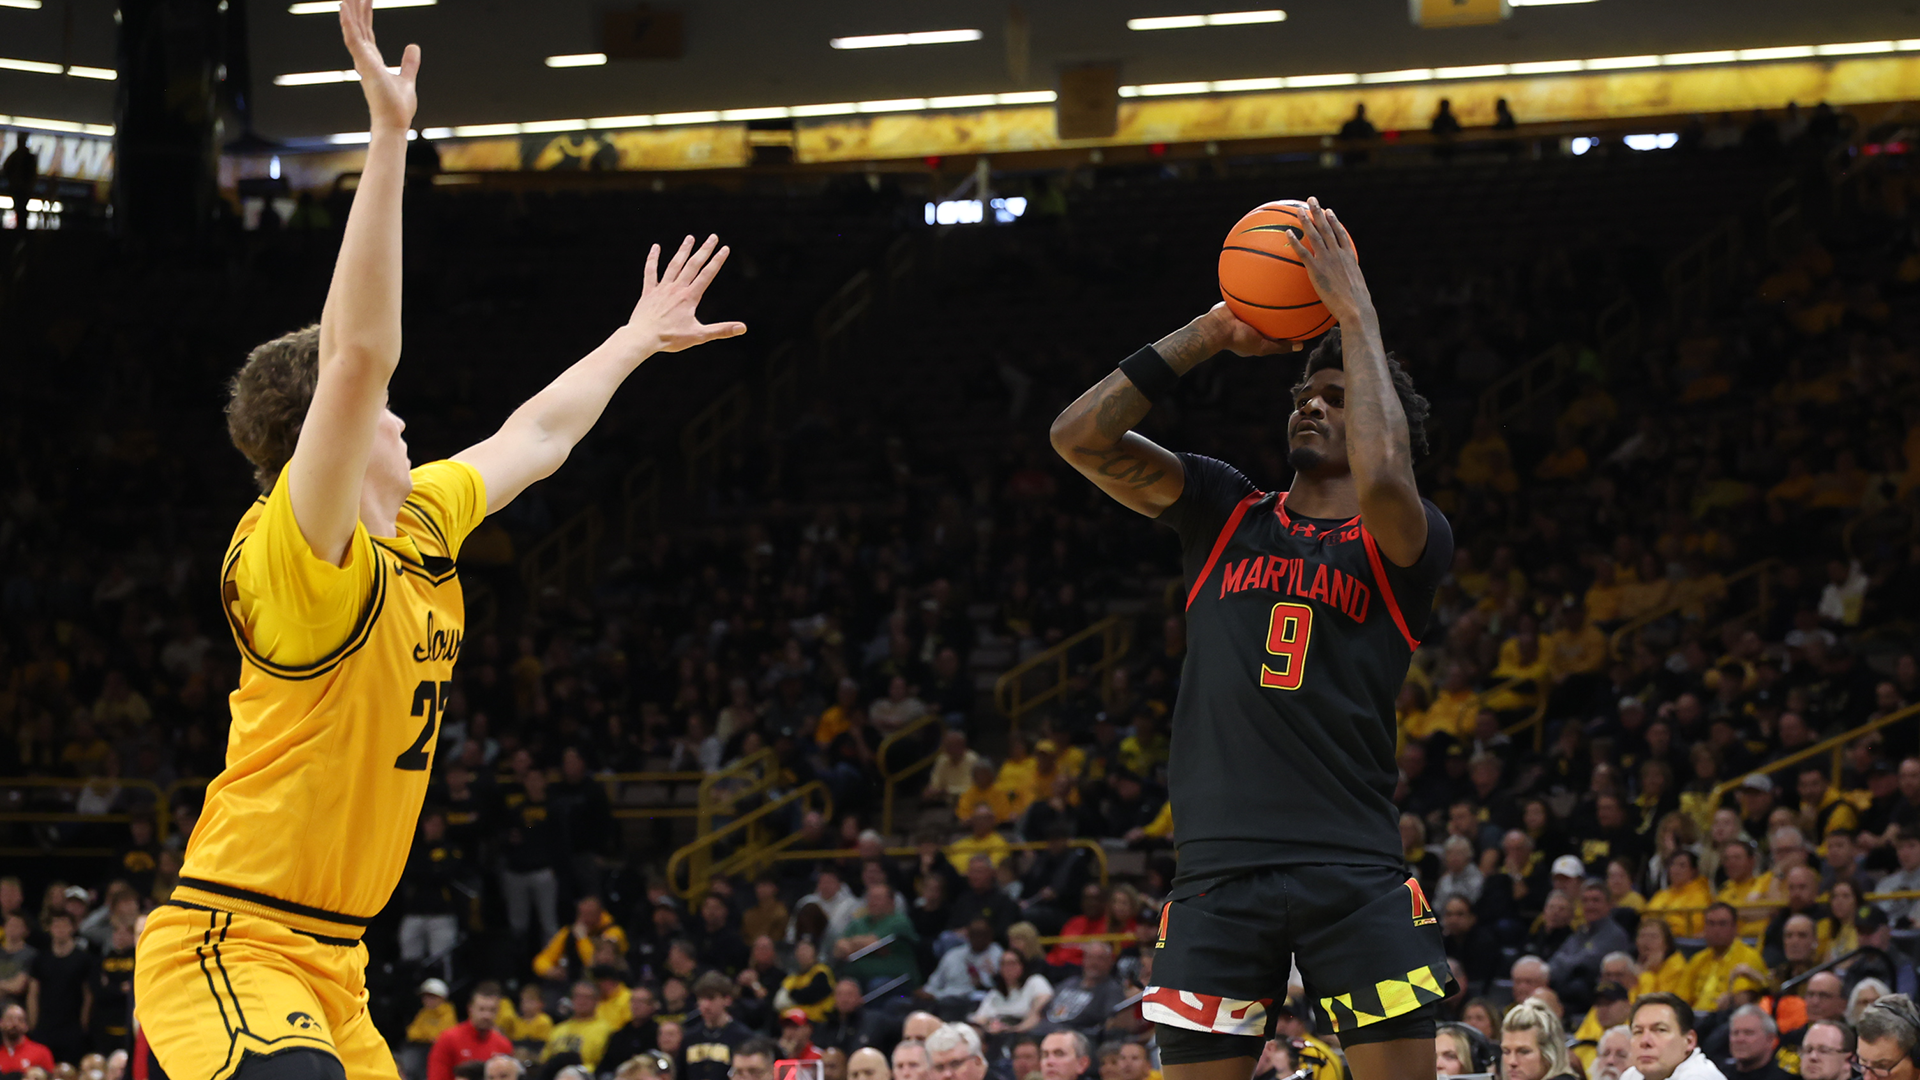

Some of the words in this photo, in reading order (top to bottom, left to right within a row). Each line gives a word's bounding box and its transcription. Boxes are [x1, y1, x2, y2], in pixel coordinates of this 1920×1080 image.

[1219, 555, 1370, 624] MARYLAND
[413, 610, 464, 663] Iow
[1260, 602, 1313, 690] 9
